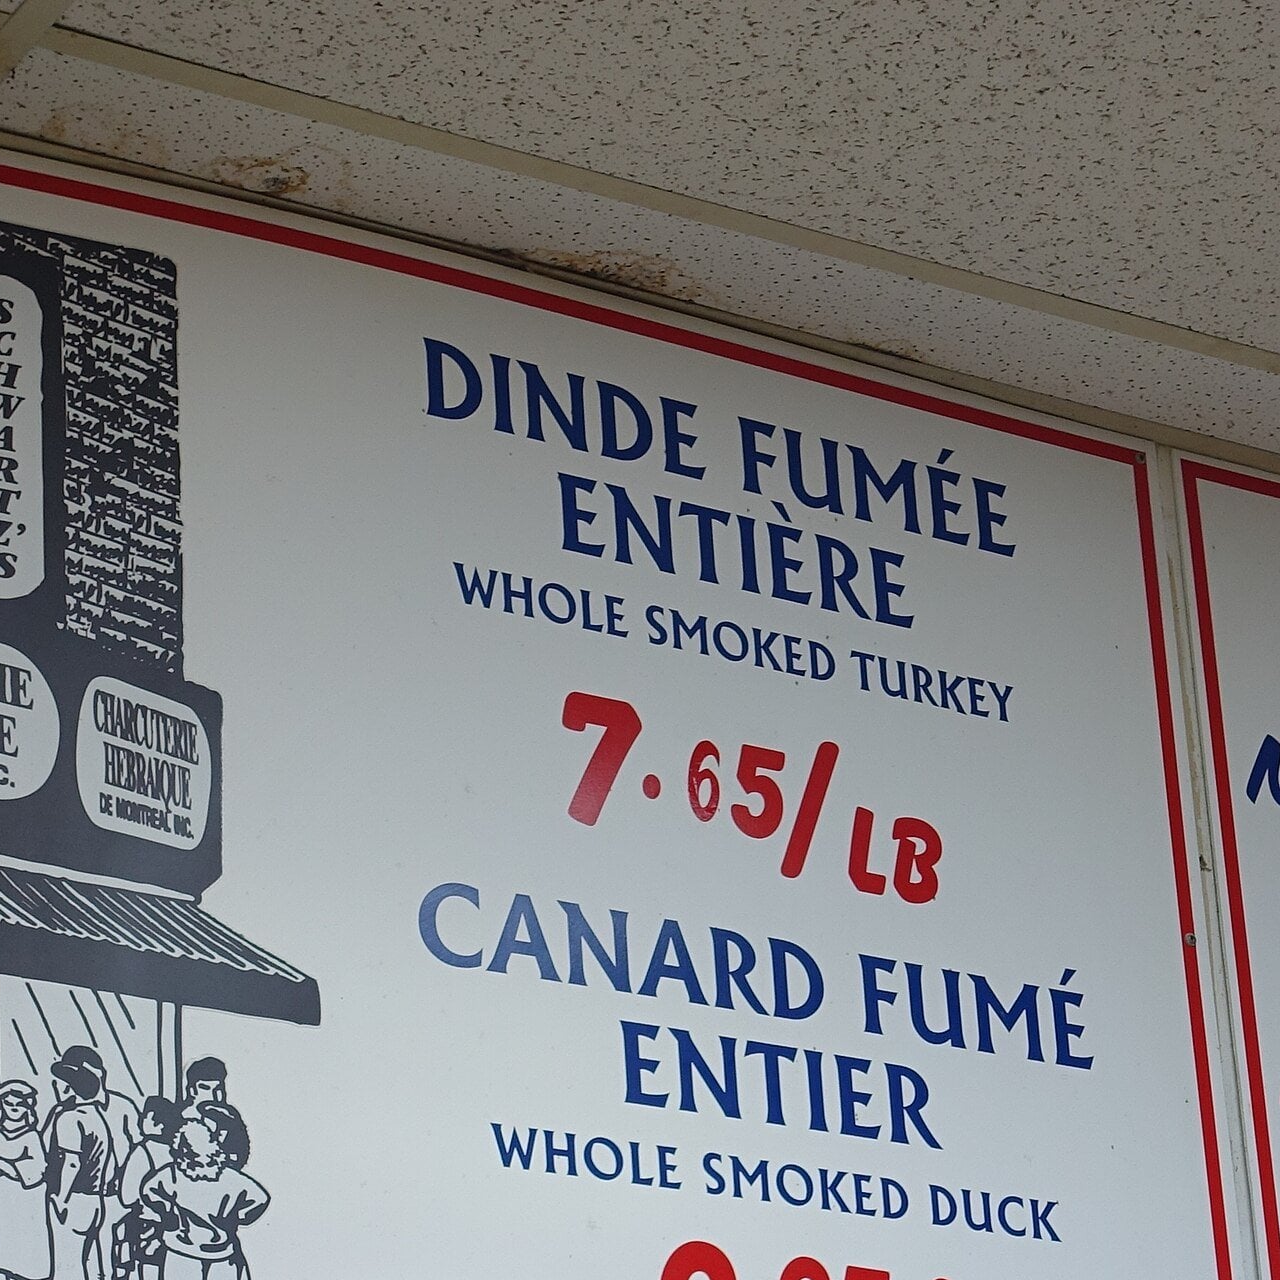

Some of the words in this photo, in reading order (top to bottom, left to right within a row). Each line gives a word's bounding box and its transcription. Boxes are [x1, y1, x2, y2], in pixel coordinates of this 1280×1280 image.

[422, 337, 706, 480] DINDE
[738, 416, 1017, 558] FUMÉE
[558, 472, 915, 628] ENTIÈRE
[453, 562, 629, 639] WHOLE
[648, 604, 836, 682] SMOKED
[851, 649, 1014, 723] TURKEY
[93, 689, 199, 766] CHARCUTERIE
[103, 741, 193, 812] HEBRAIQUE
[99, 794, 114, 817] DE
[116, 796, 172, 834] MONTREAL
[175, 814, 195, 840] INC.
[418, 882, 825, 1021] CANARD
[859, 954, 1094, 1071] FUMÉ
[620, 1019, 943, 1149] ENTIER
[490, 1122, 682, 1190] WHOLE
[704, 1152, 910, 1220] SMOKED
[929, 1183, 1062, 1242] DUCK
